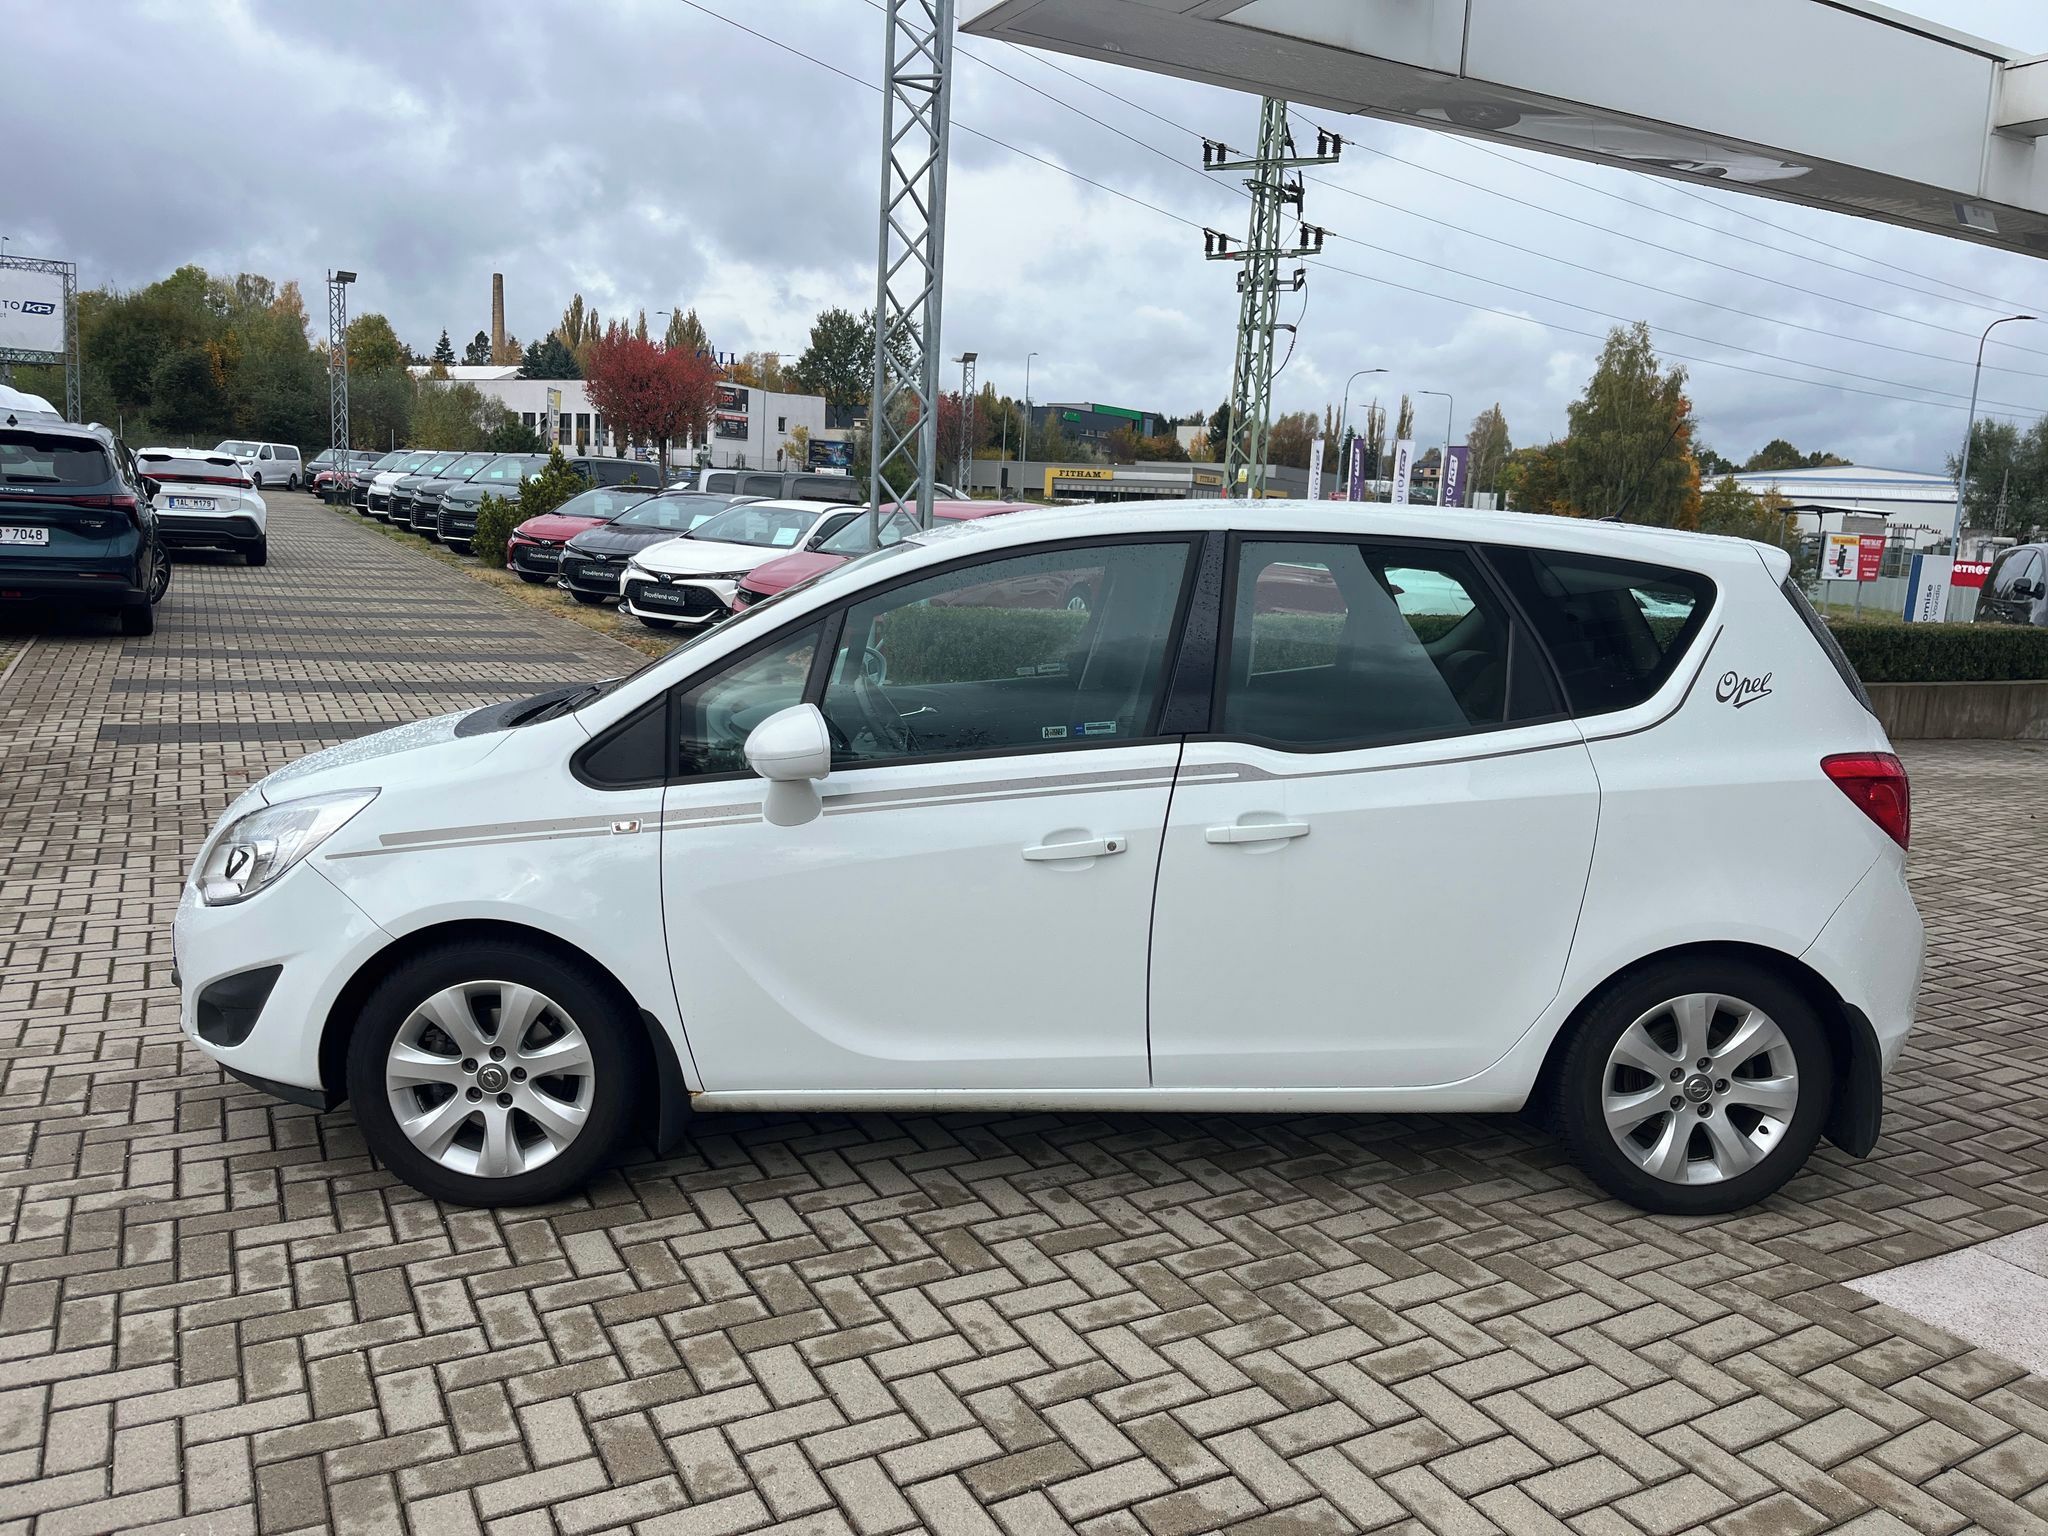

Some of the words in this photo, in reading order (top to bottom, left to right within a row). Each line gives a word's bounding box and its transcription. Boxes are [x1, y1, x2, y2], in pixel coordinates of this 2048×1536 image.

[1059, 469, 1102, 479] FITHAM
[667, 595, 680, 603] vozy
[1715, 670, 1773, 709] Opel
